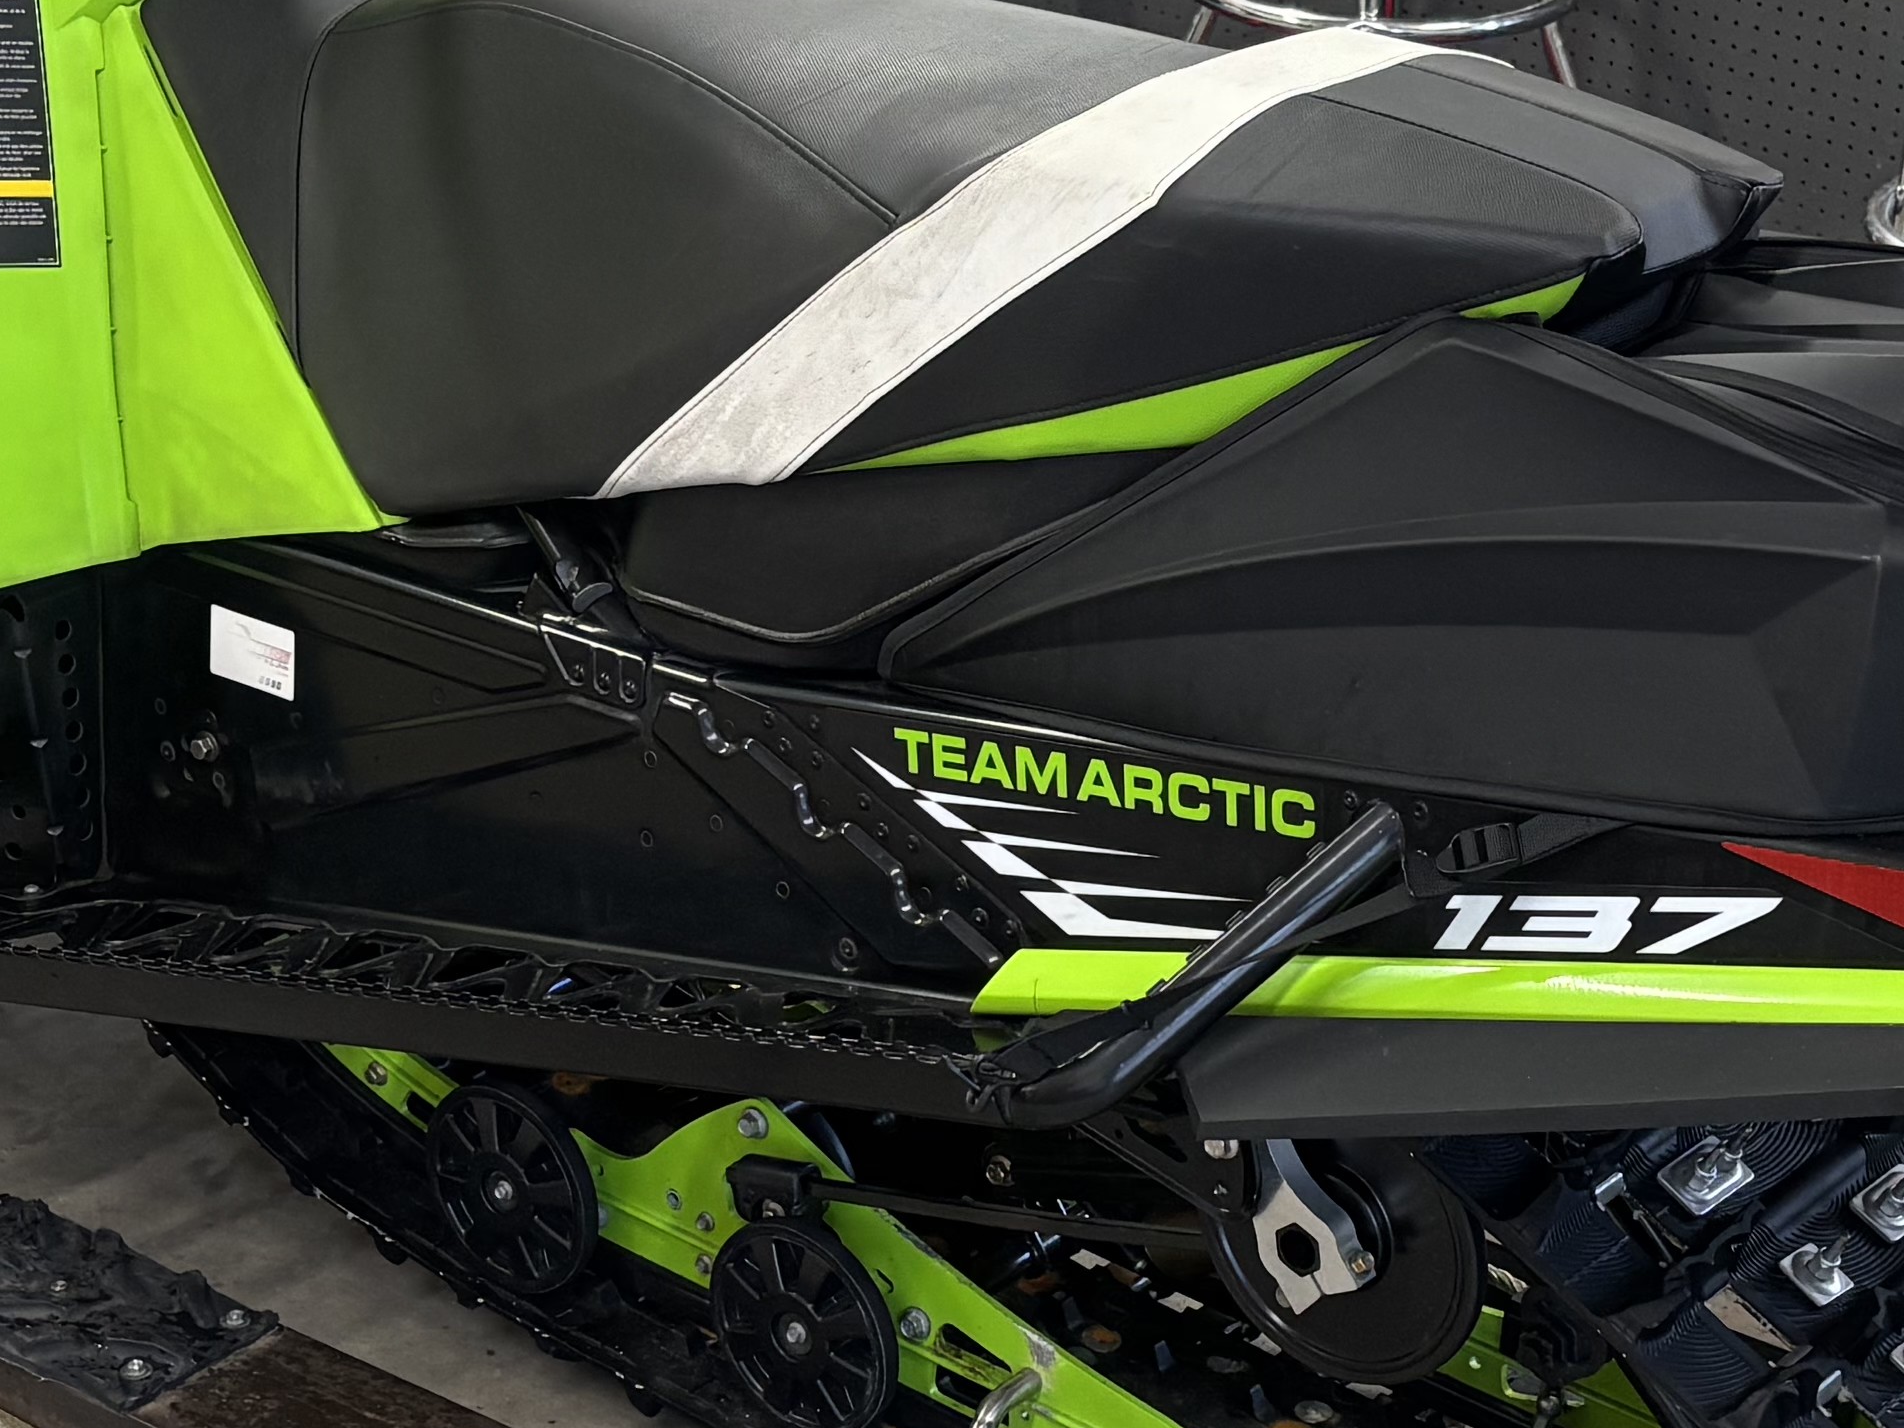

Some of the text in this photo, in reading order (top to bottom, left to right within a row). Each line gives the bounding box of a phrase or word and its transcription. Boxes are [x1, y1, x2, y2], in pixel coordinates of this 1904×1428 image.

[894, 727, 1318, 840] TEAM ARCTIC
[1433, 893, 1784, 956] 137
